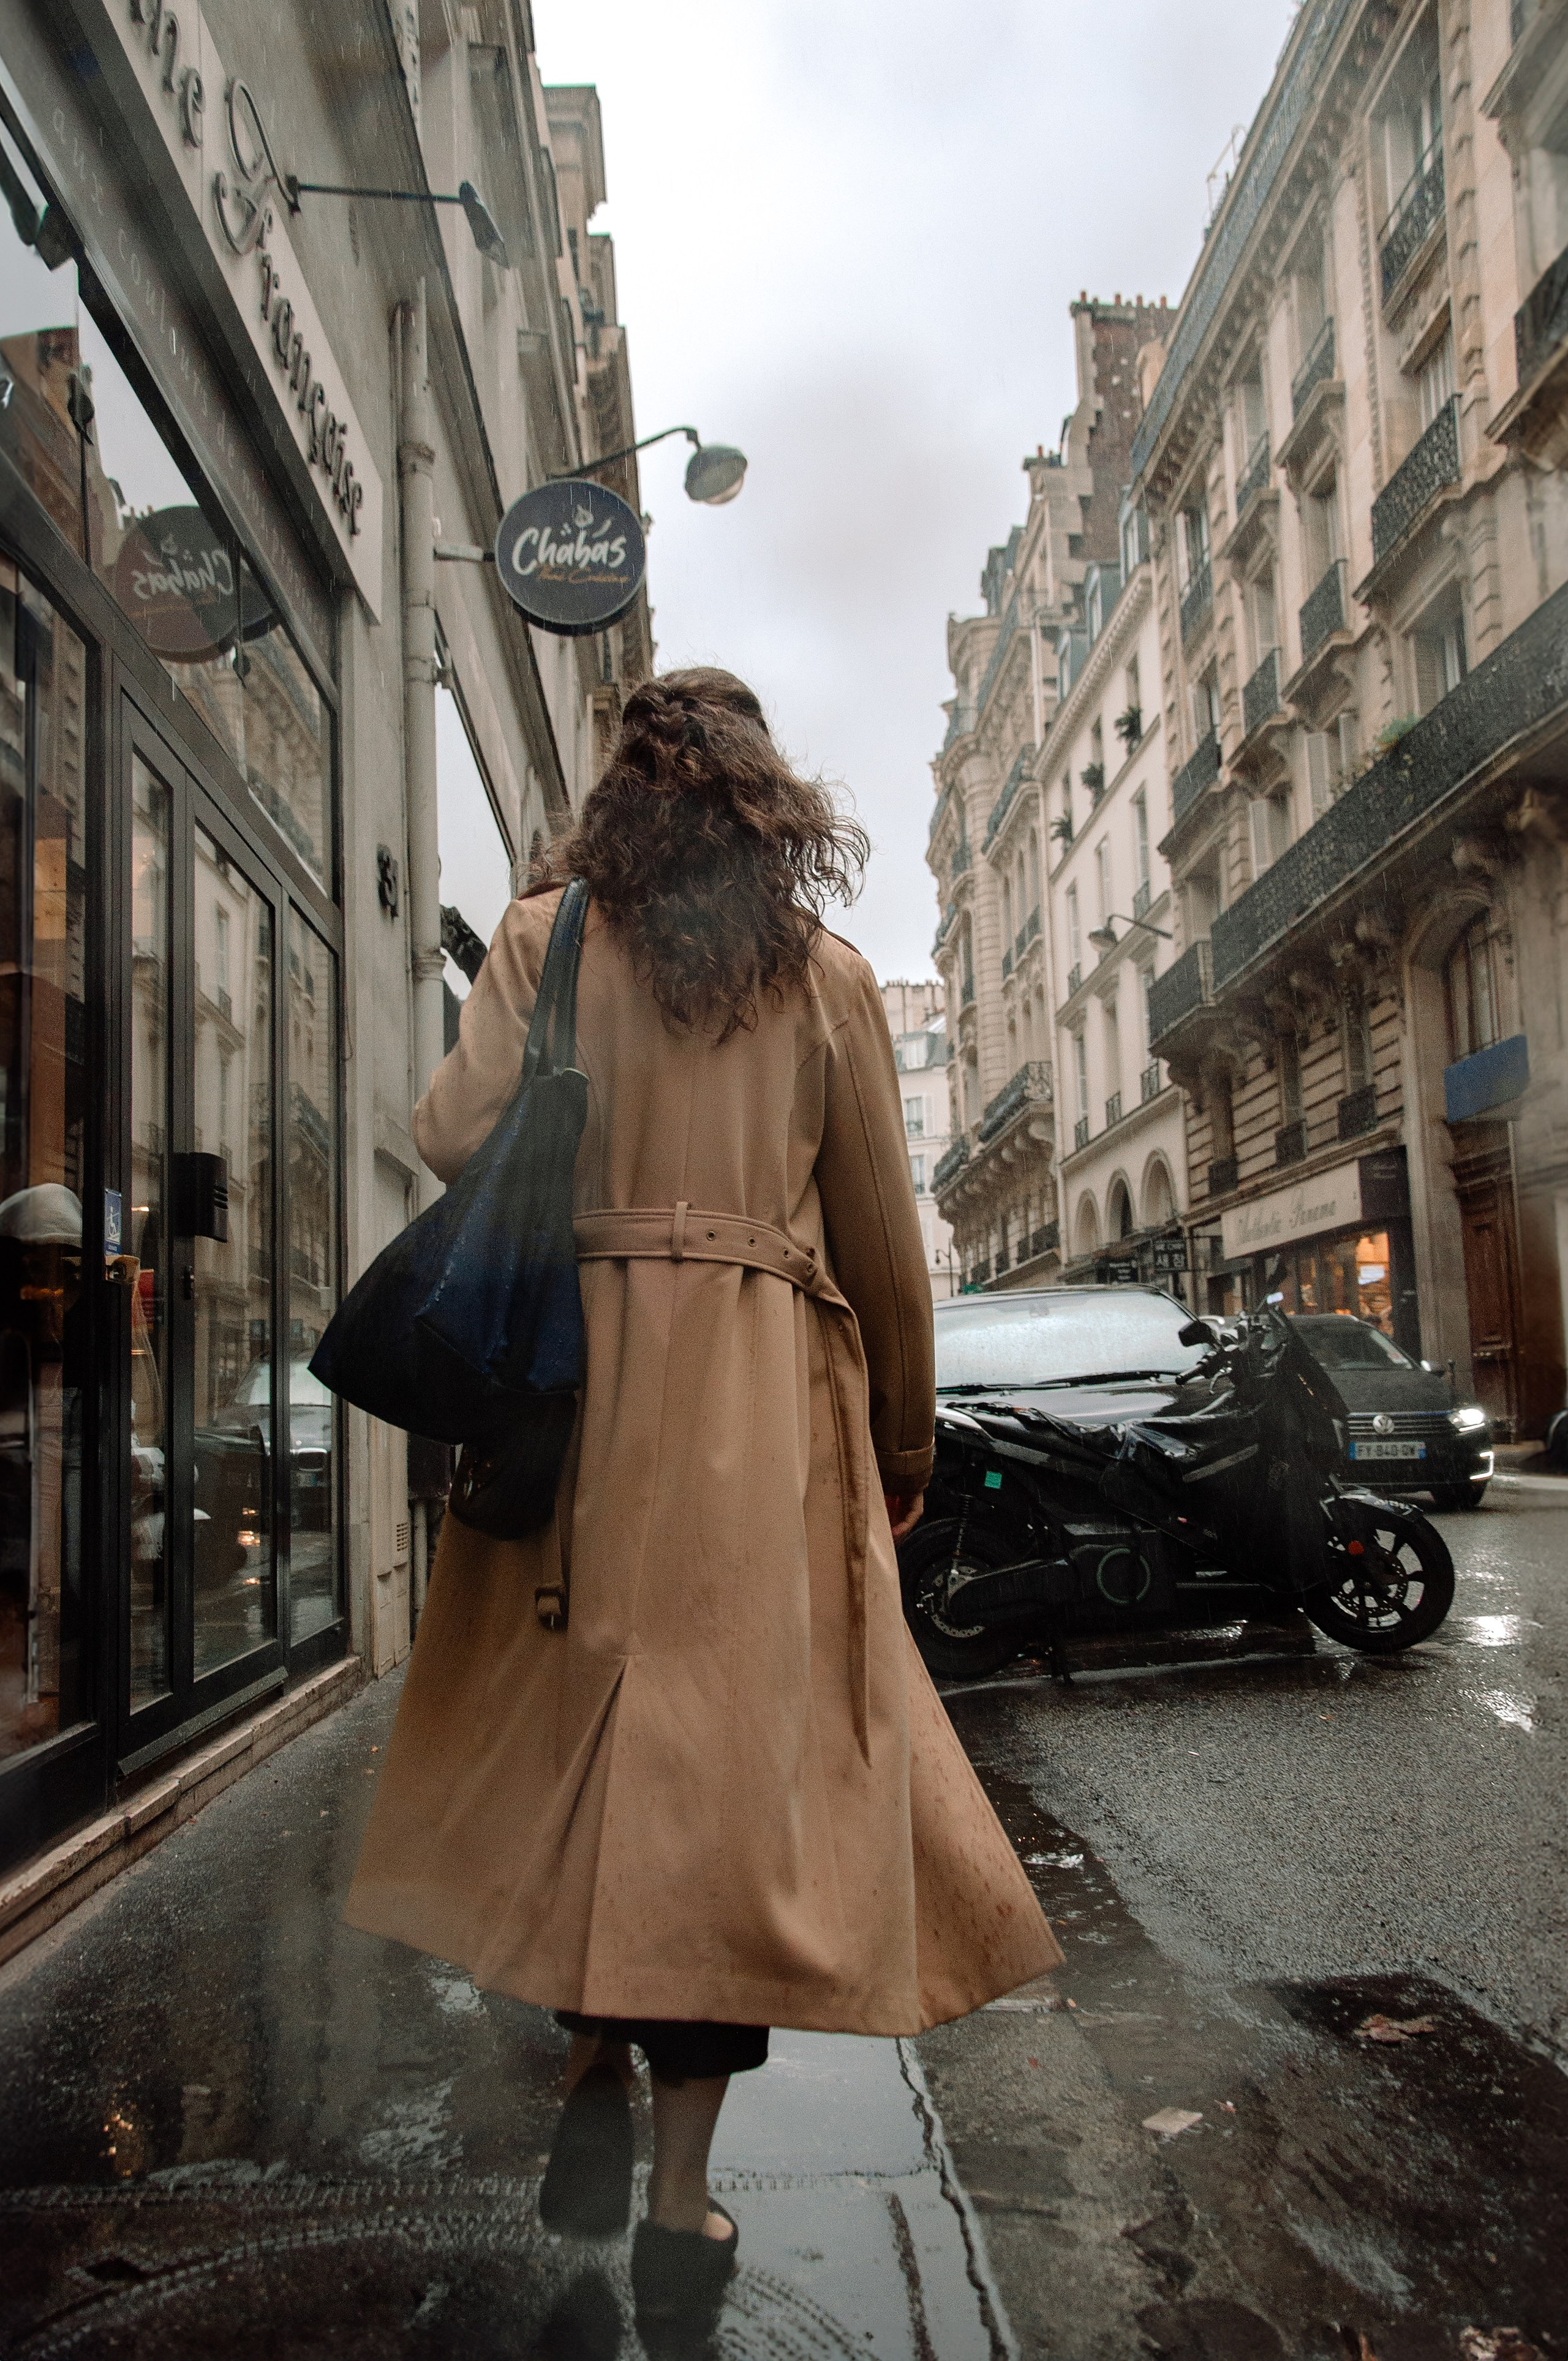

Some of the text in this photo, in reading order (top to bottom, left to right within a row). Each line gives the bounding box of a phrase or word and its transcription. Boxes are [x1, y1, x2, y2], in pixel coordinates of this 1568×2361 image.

[52, 108, 103, 217] aux
[118, 228, 208, 415] couleurs
[216, 409, 235, 468] de
[214, 78, 363, 535] Française
